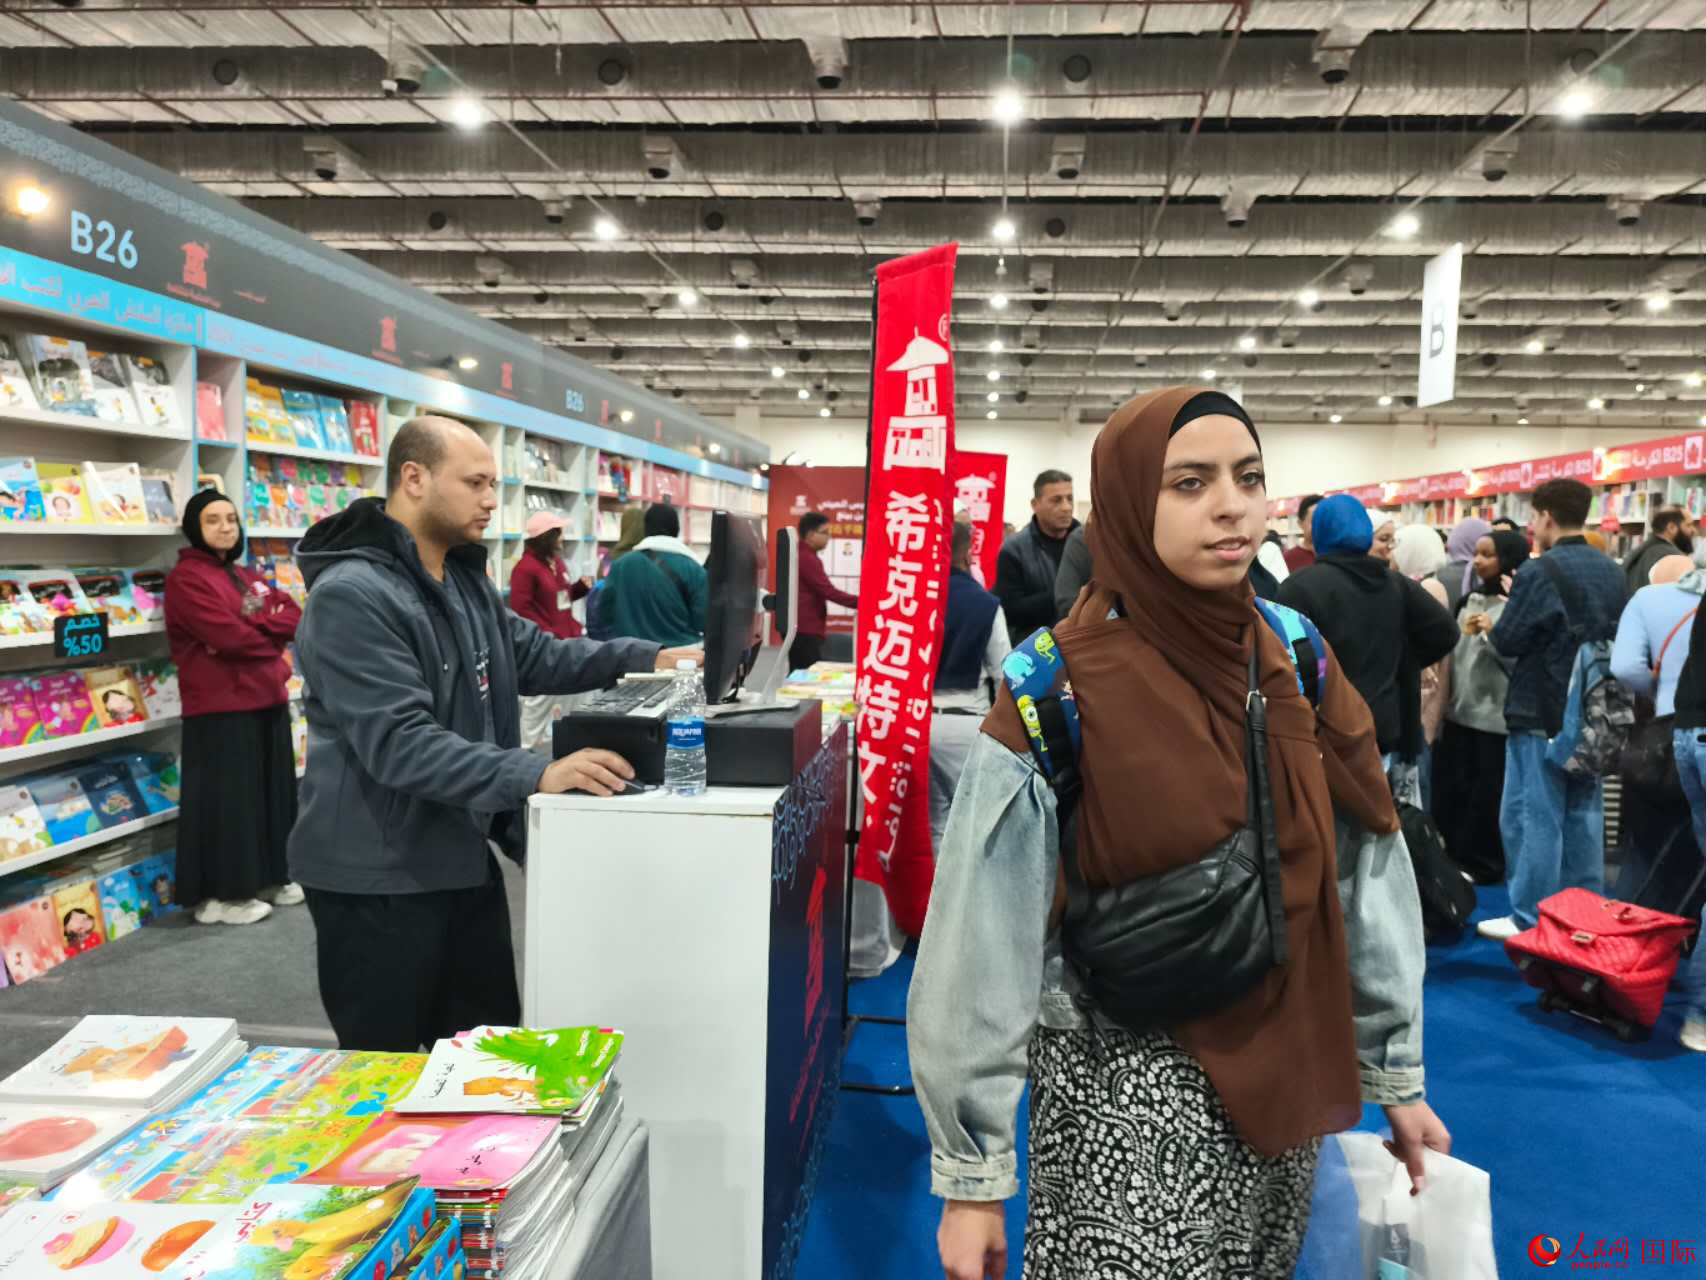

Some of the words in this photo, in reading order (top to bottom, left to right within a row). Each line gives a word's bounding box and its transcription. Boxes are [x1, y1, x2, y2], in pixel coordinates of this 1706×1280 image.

[70, 210, 138, 269] B26
[1429, 303, 1445, 359] B
[63, 614, 100, 637] خصم
